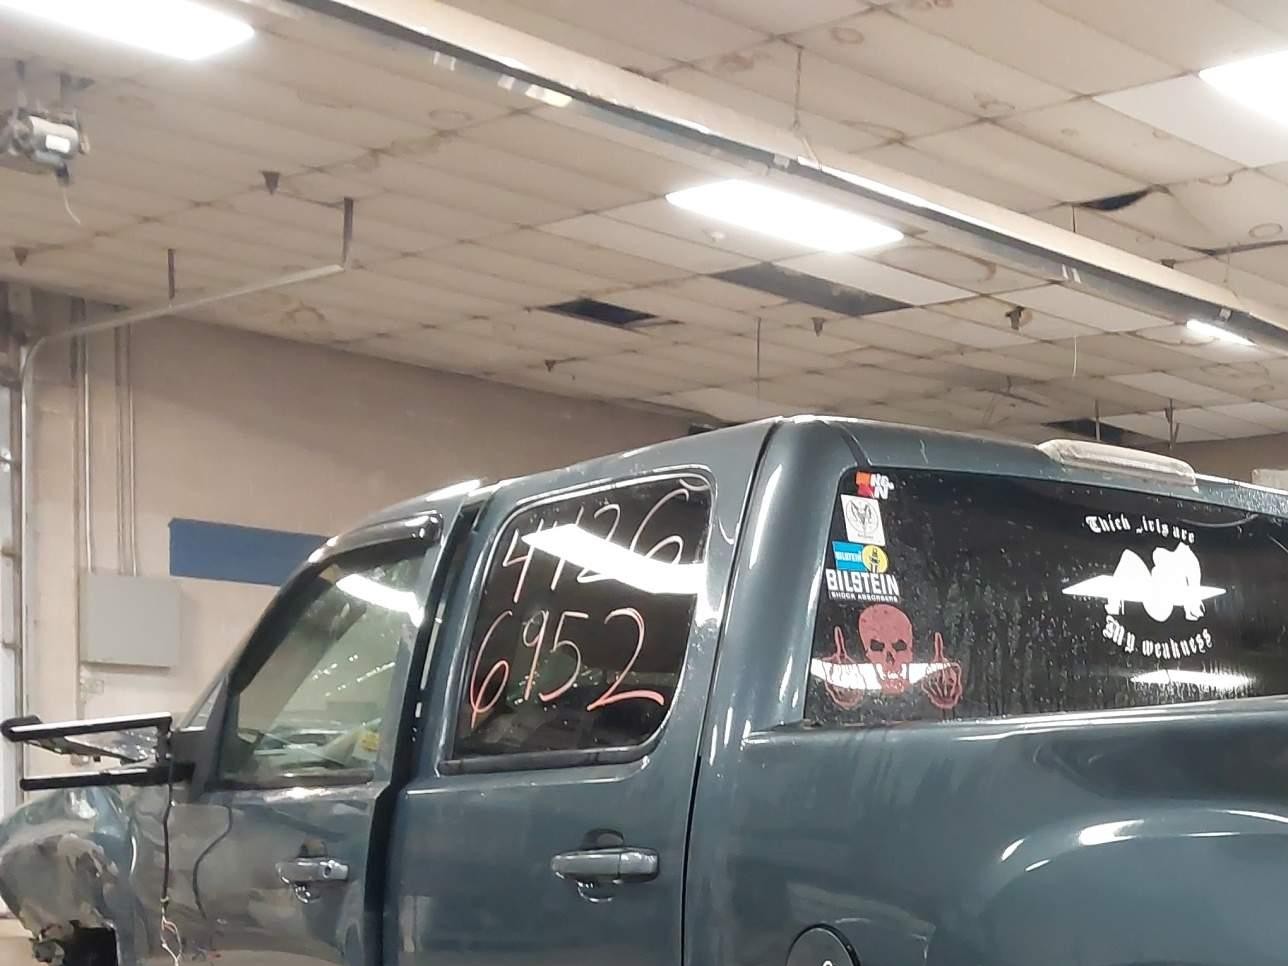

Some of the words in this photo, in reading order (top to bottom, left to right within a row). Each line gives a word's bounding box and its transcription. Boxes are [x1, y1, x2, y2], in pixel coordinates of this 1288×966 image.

[1136, 516, 1169, 537] irls
[825, 568, 900, 596] BILSTEIN
[469, 606, 666, 729] 6952
